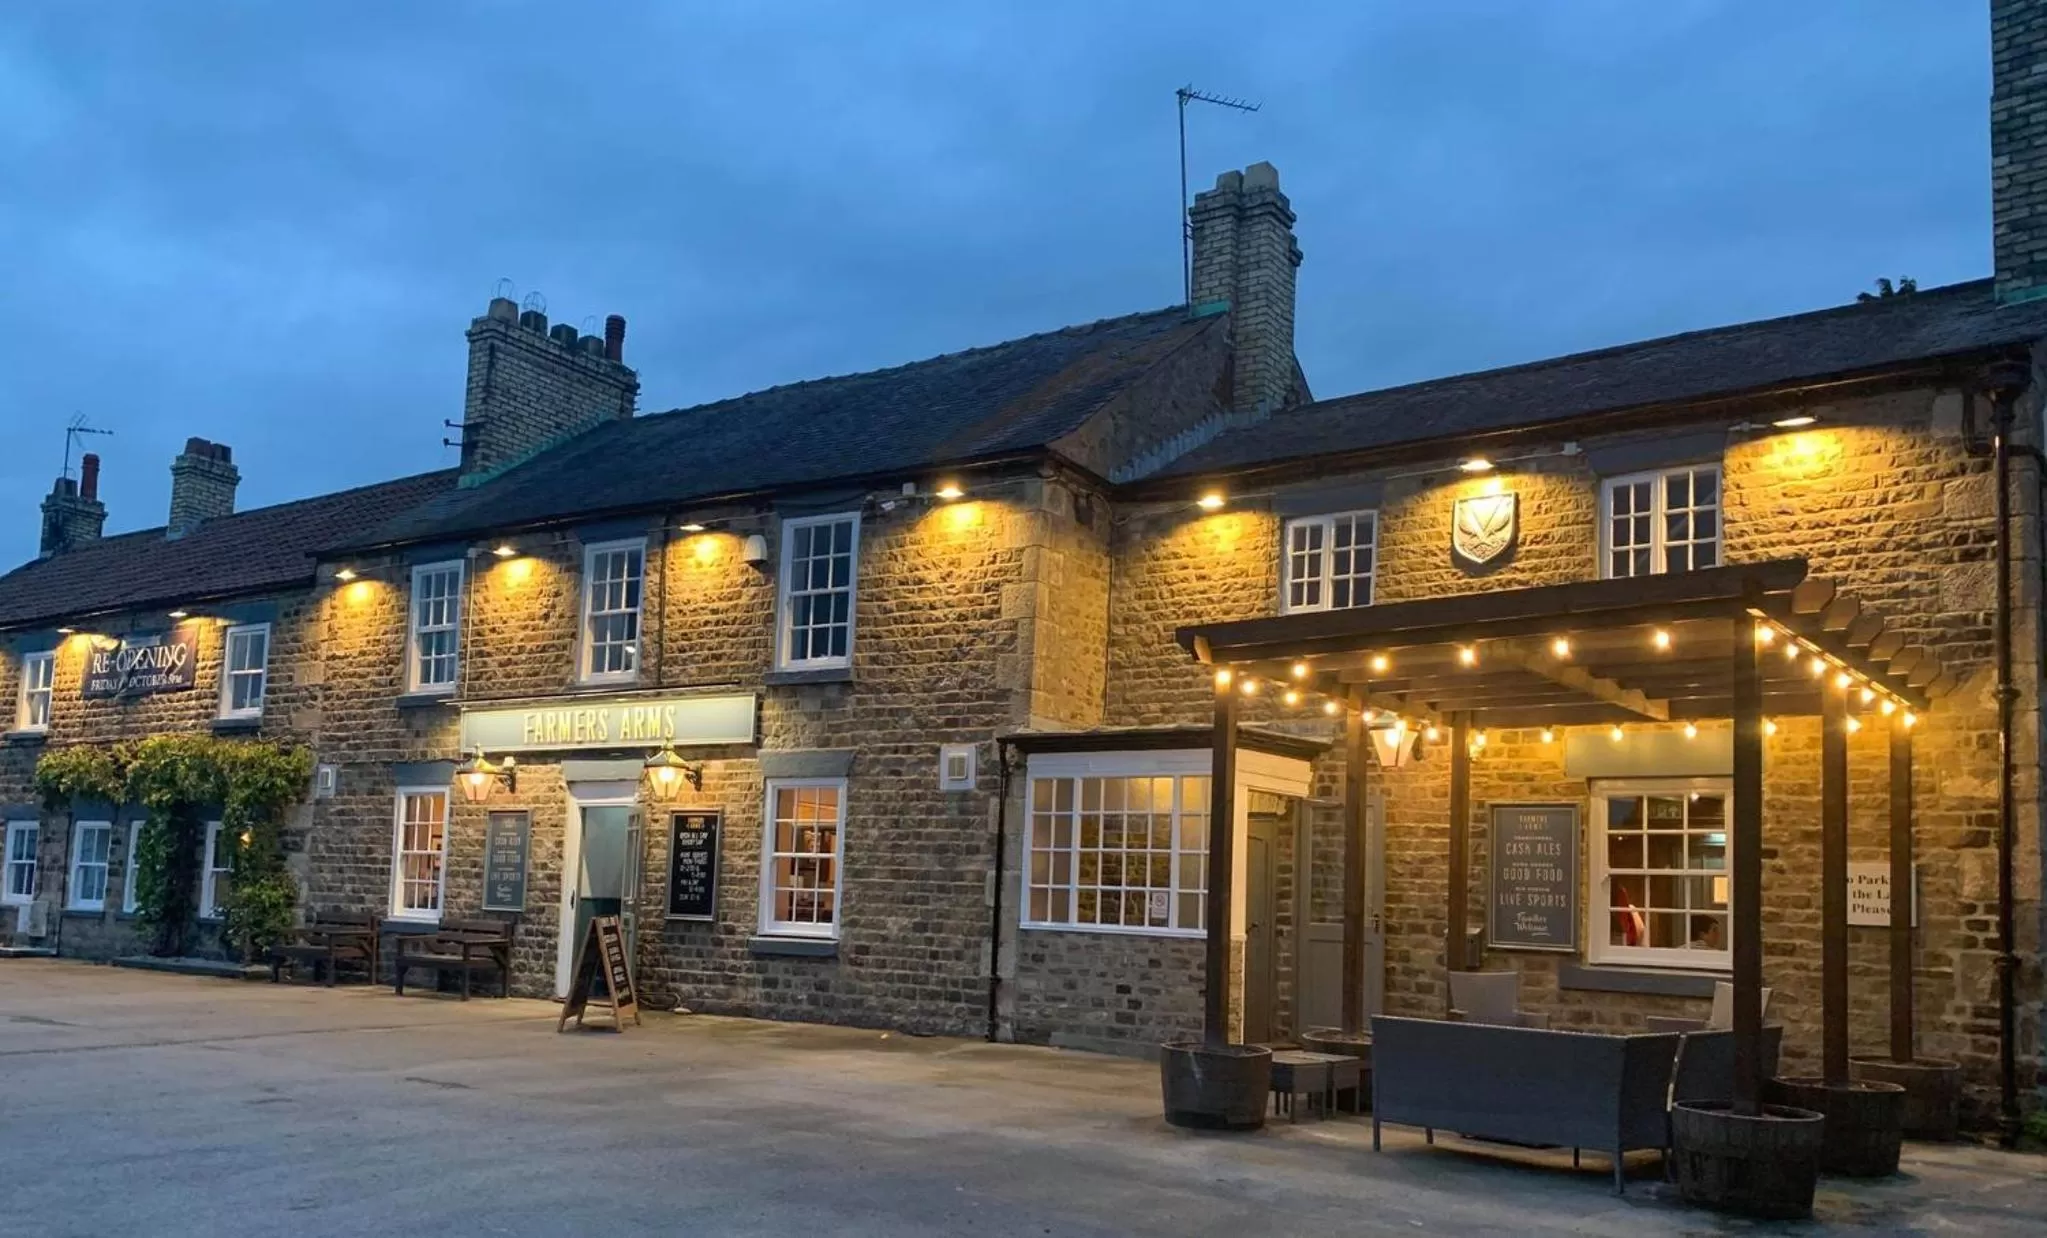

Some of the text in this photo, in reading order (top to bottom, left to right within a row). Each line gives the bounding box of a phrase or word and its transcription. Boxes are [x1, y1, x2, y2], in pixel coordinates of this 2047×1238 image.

[92, 643, 187, 674] RE-OPENING
[523, 705, 675, 744] FARMERS ARMS
[1535, 867, 1564, 882] FOOD
[1858, 874, 1889, 885] Park
[1499, 892, 1567, 908] LIVE SPORTS
[1852, 889, 1871, 899] the
